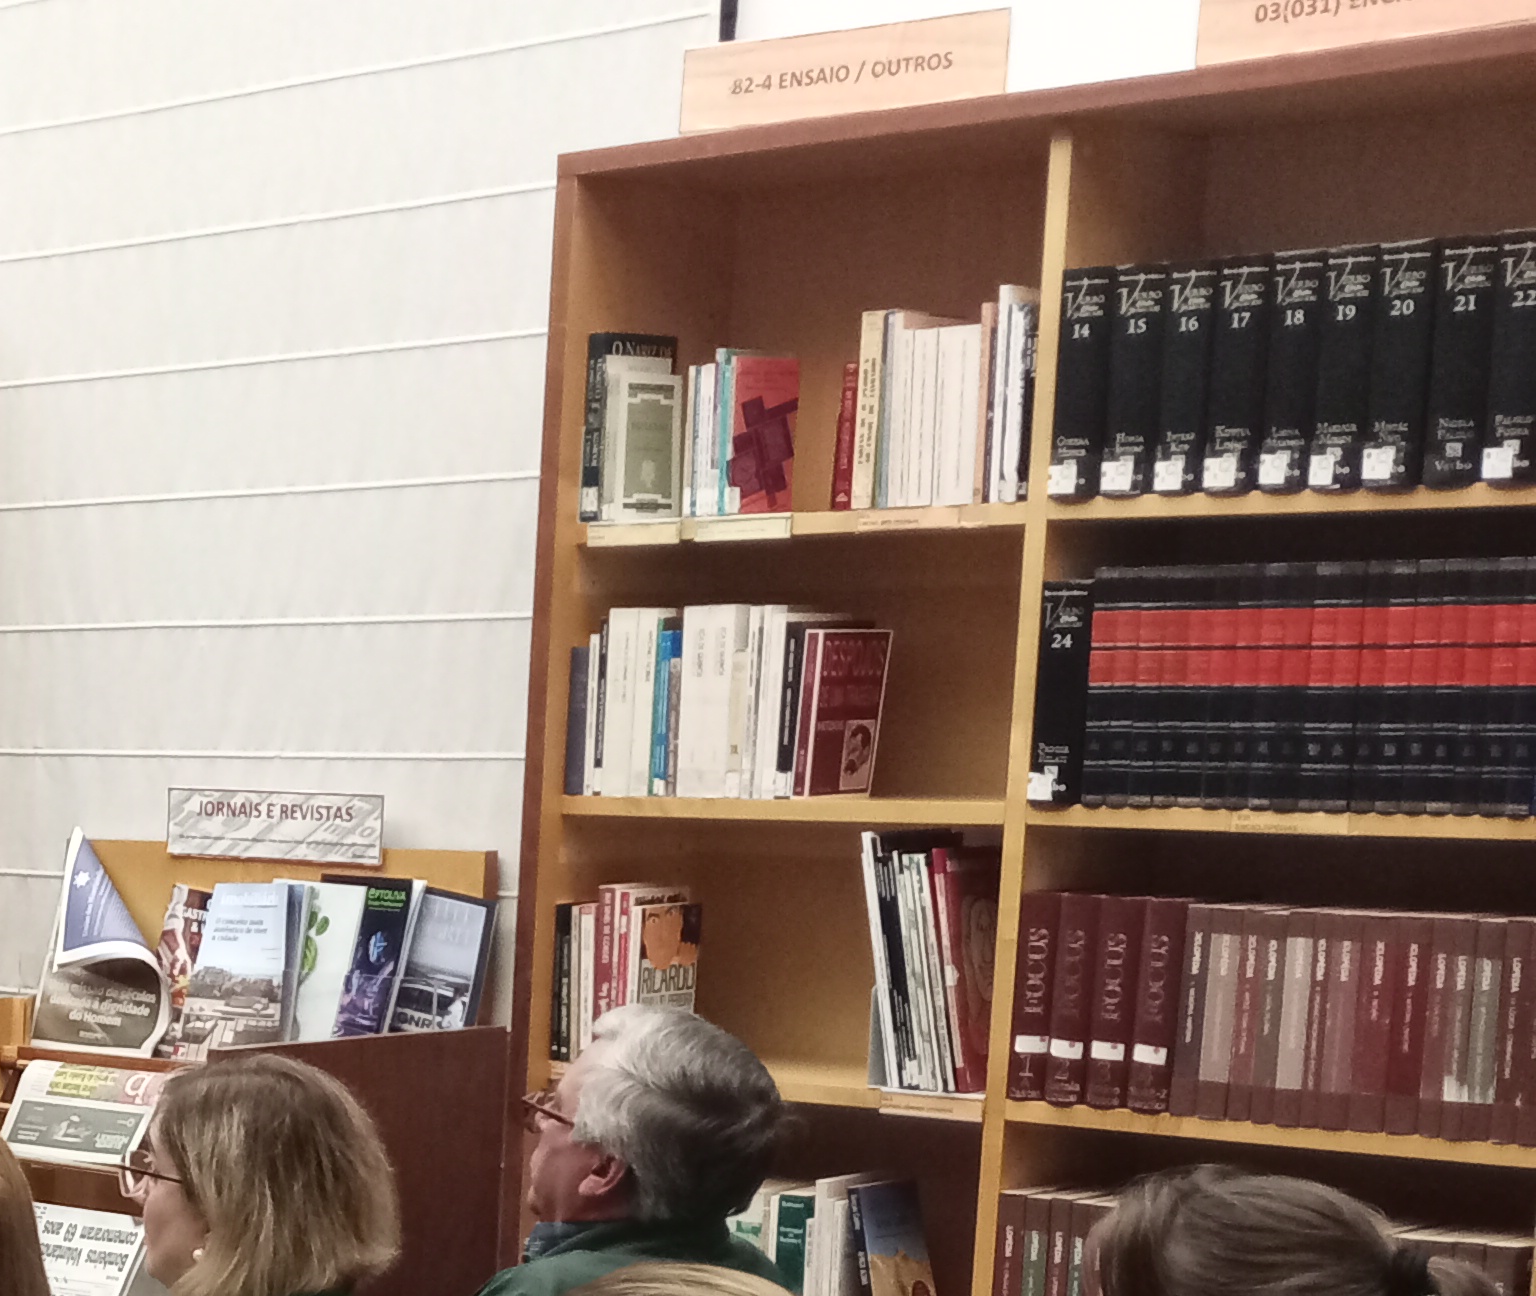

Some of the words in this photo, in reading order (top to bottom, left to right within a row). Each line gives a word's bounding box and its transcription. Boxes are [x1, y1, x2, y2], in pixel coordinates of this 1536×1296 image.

[730, 74, 772, 95] 82-4
[778, 64, 849, 90] ENSAIO
[854, 60, 866, 84] /
[871, 51, 954, 79] OUTROS
[1390, 299, 1415, 316] 20
[1453, 295, 1477, 312] 21
[1512, 291, 1536, 307] 22
[1230, 312, 1251, 328] 17
[1284, 309, 1305, 326] 18
[1336, 305, 1357, 321] 19
[1071, 324, 1090, 339] 14
[1127, 318, 1146, 334] 15
[1179, 316, 1199, 332] 16
[1051, 634, 1073, 649] 24
[197, 800, 261, 818] JORNAIS
[266, 803, 275, 818] E
[280, 804, 353, 822] REVISTAS
[1024, 928, 1049, 1015] FOCUS
[1101, 933, 1127, 1020] FOCUS
[1146, 935, 1170, 1022] FOCUS
[120, 988, 157, 1003] séculos
[101, 998, 150, 1017] dignidade
[69, 1009, 82, 1021] do
[83, 1011, 122, 1027] Homem
[42, 1220, 64, 1236] anos
[63, 1222, 77, 1242] 69
[85, 1249, 129, 1272] Bombeiros
